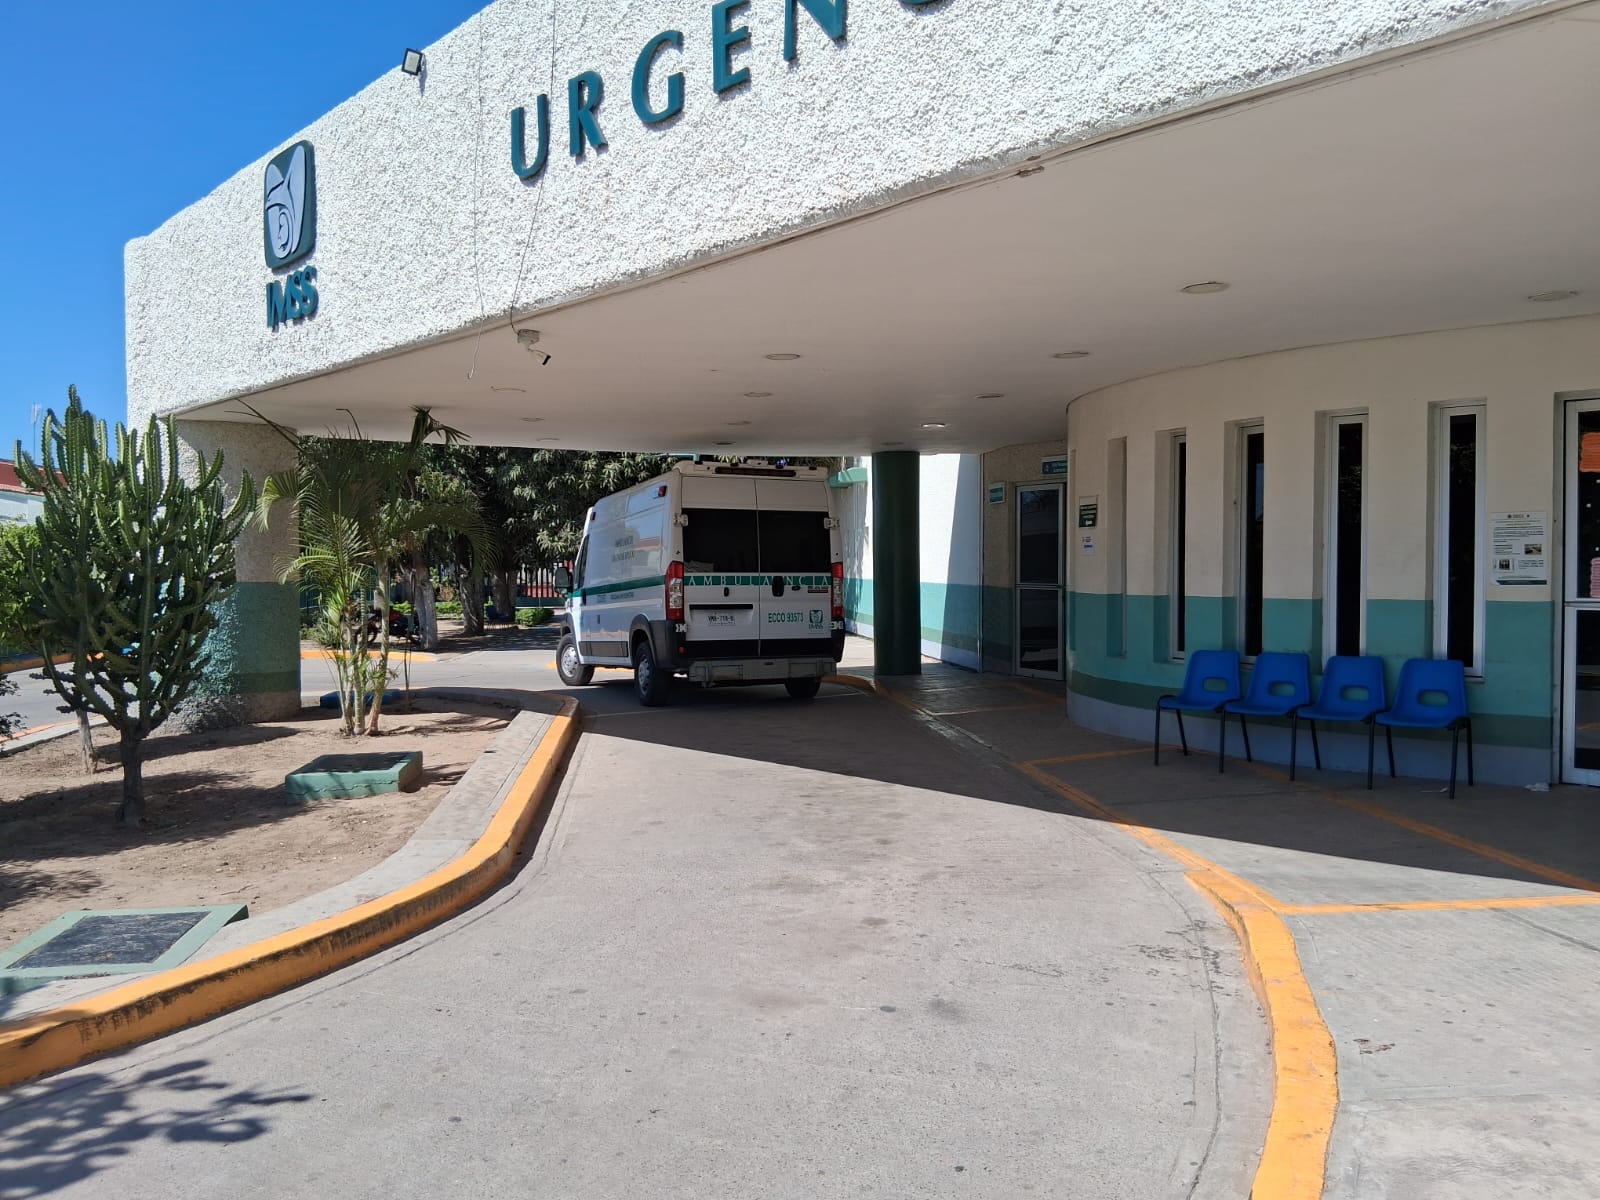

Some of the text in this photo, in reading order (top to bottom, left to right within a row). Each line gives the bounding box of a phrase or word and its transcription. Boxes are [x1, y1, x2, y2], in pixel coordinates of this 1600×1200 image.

[511, 0, 945, 181] URGEN
[266, 265, 319, 328] IMSS
[688, 576, 829, 586] AMBULANCIA
[768, 612, 804, 623] ECCO 93573
